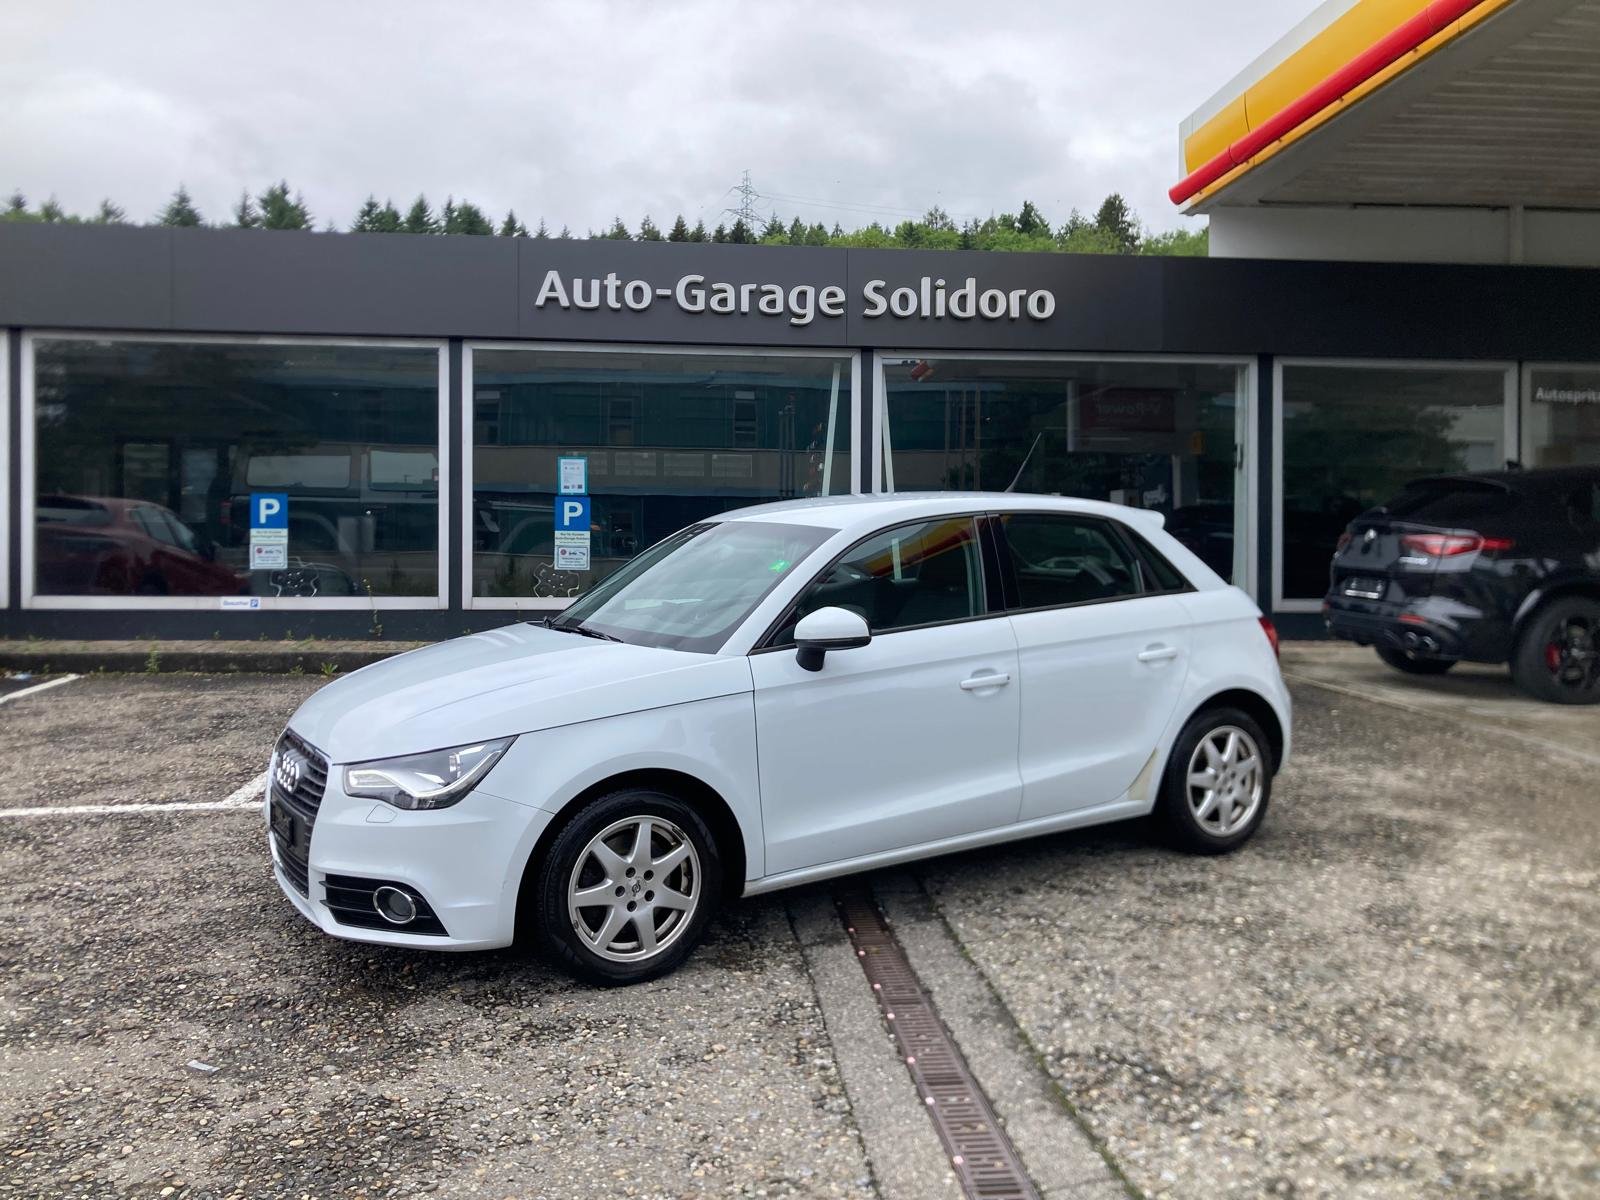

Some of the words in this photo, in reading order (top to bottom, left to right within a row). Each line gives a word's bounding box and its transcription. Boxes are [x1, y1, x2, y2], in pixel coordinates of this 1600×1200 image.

[535, 270, 846, 326] Auto-Garage
[863, 277, 1056, 320] Solidoro
[259, 498, 280, 524] P
[563, 501, 583, 526] P
